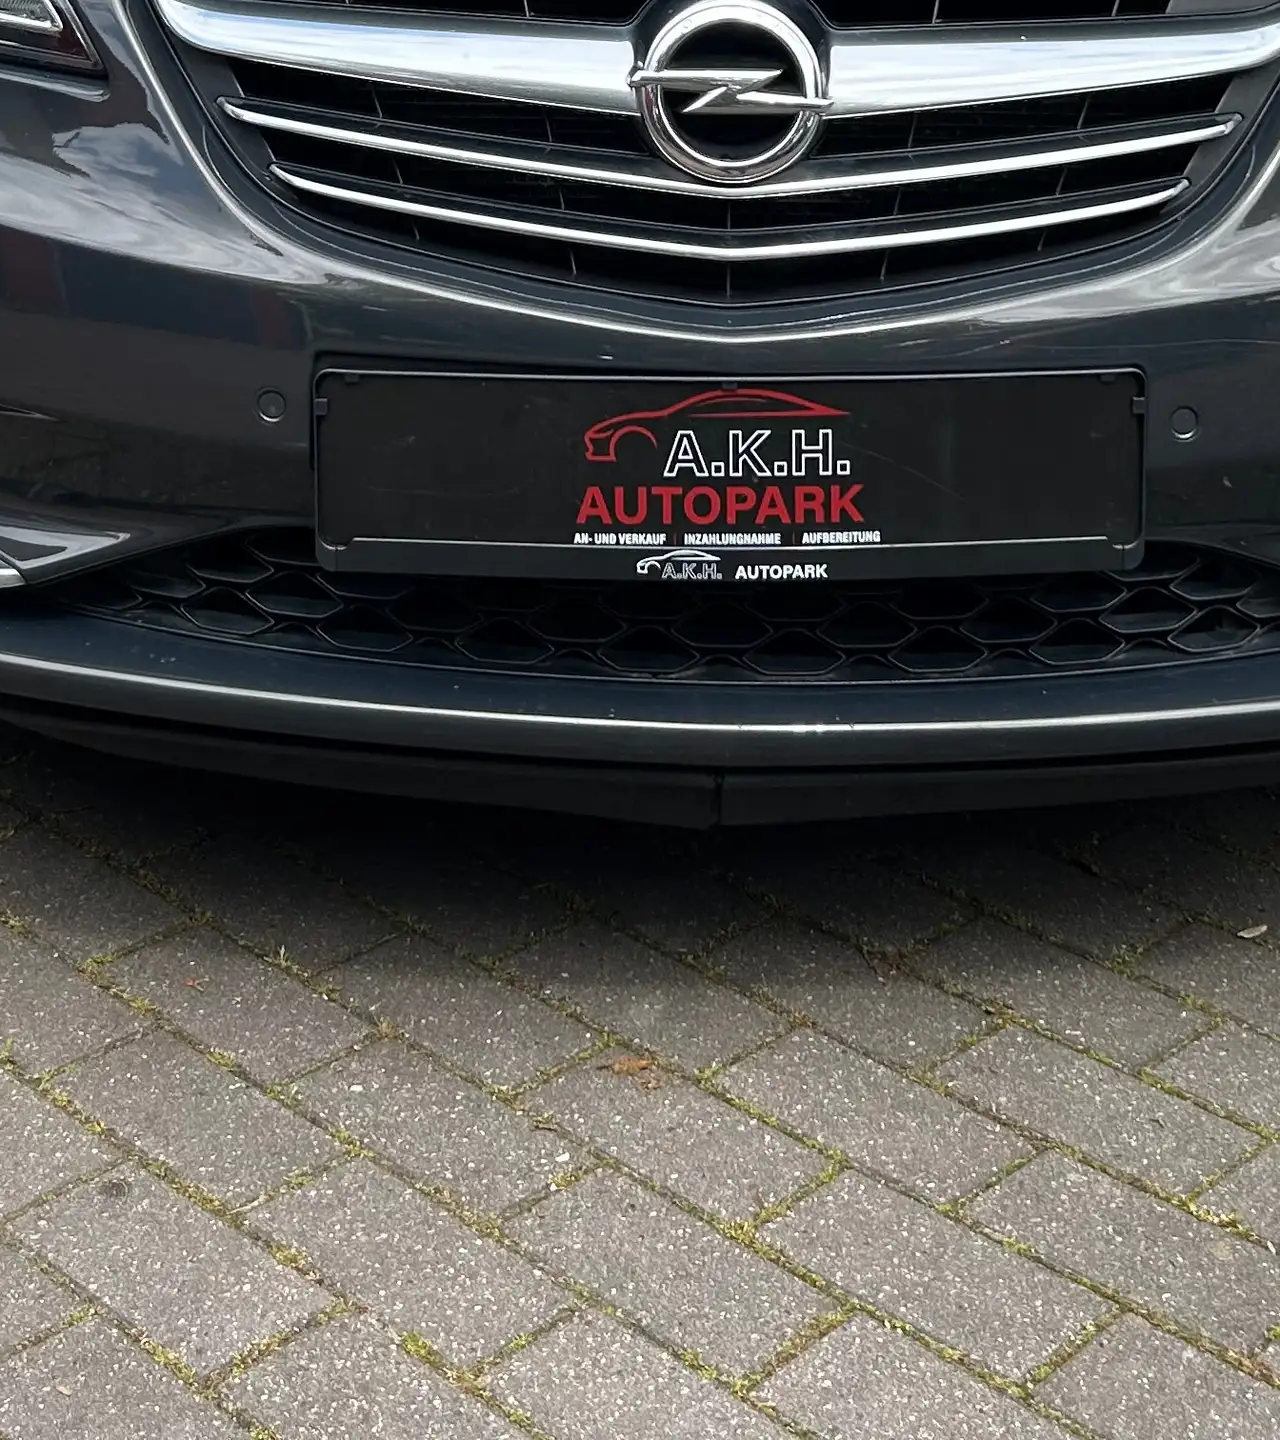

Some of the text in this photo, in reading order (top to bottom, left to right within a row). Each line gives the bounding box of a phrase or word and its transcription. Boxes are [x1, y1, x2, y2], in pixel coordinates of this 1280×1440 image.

[663, 428, 851, 477] A.K.H.
[575, 483, 865, 526] AUTOPARK
[573, 530, 881, 546] AN- UND VERKAUF INZAHLUNGNAHME AUFBEREITUNG
[661, 562, 829, 580] A.K.H. AUTOPARK
